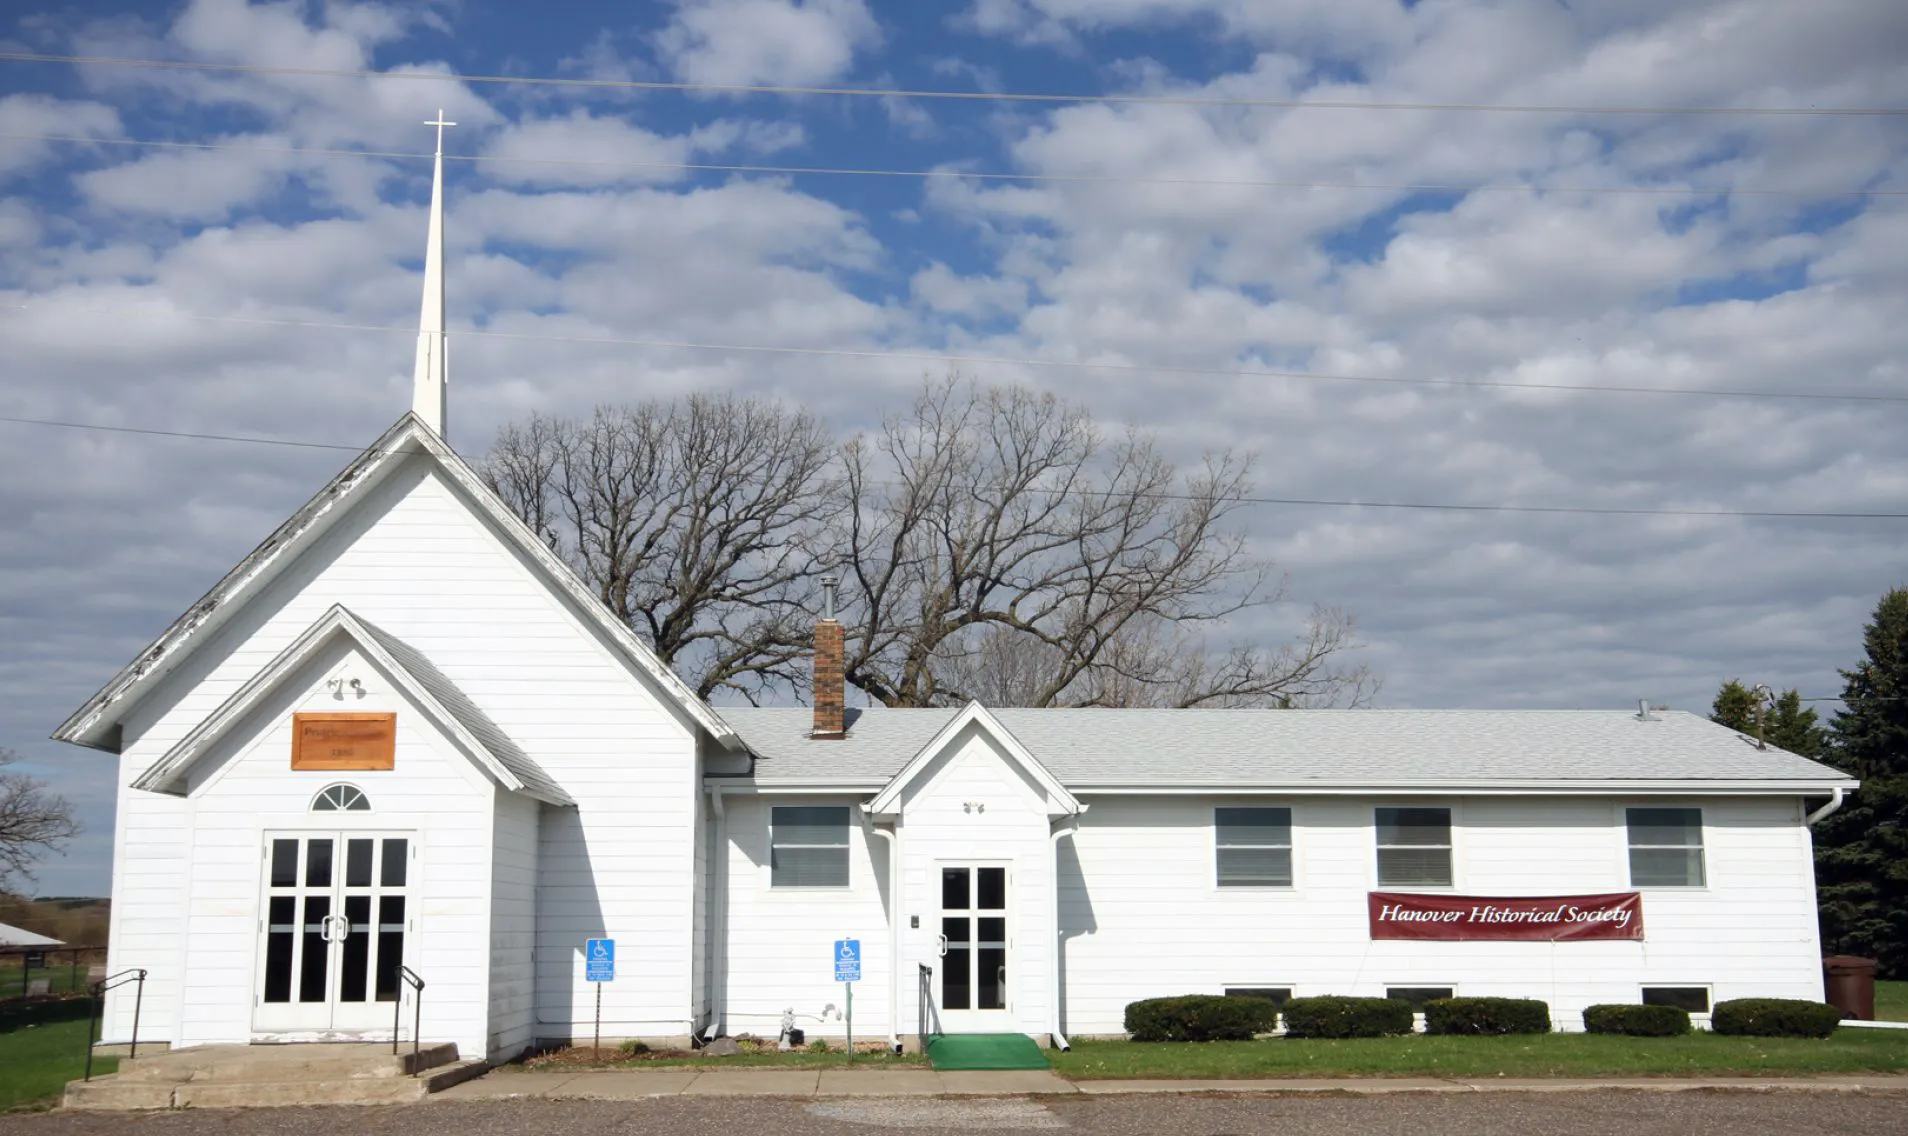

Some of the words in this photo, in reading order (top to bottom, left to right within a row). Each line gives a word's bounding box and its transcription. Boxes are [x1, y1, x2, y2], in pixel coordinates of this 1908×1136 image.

[1378, 904, 1465, 922] Hanover
[1467, 904, 1567, 923] Historical
[1565, 906, 1632, 928] Society
